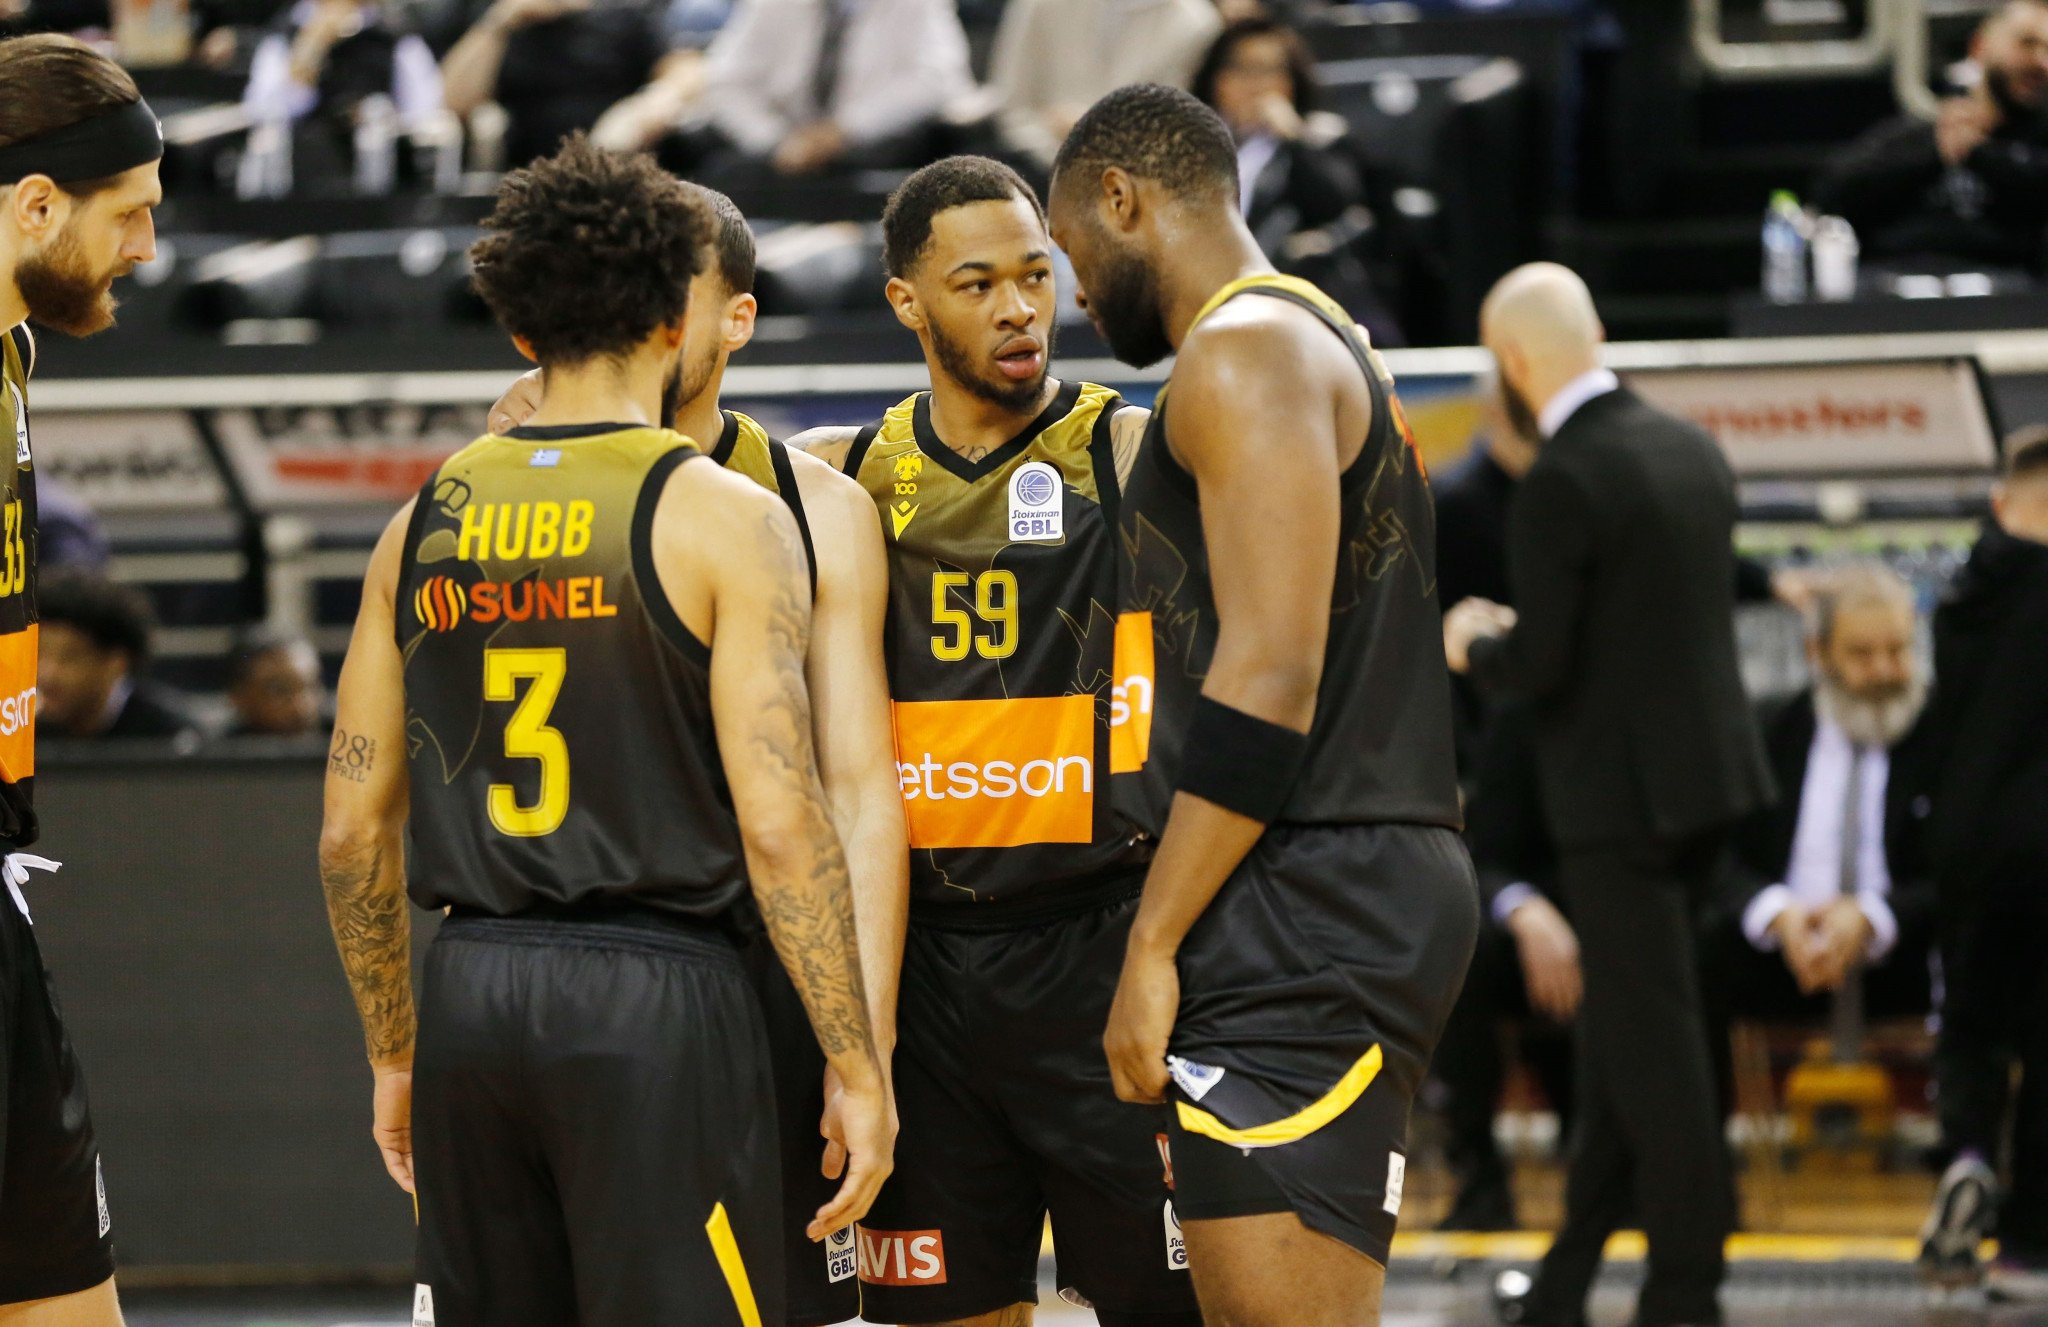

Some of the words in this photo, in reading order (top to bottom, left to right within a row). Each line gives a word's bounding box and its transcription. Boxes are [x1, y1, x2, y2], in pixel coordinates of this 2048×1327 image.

[893, 482, 918, 495] 100
[457, 499, 596, 562] HUBB
[1011, 509, 1060, 519] Stoiximan
[1013, 519, 1058, 537] GBL
[469, 575, 618, 623] SUNEL
[930, 569, 1019, 662] 59
[330, 730, 368, 769] 28
[483, 647, 571, 838] 3
[896, 752, 1092, 800] etsson
[830, 1256, 855, 1278] GBL
